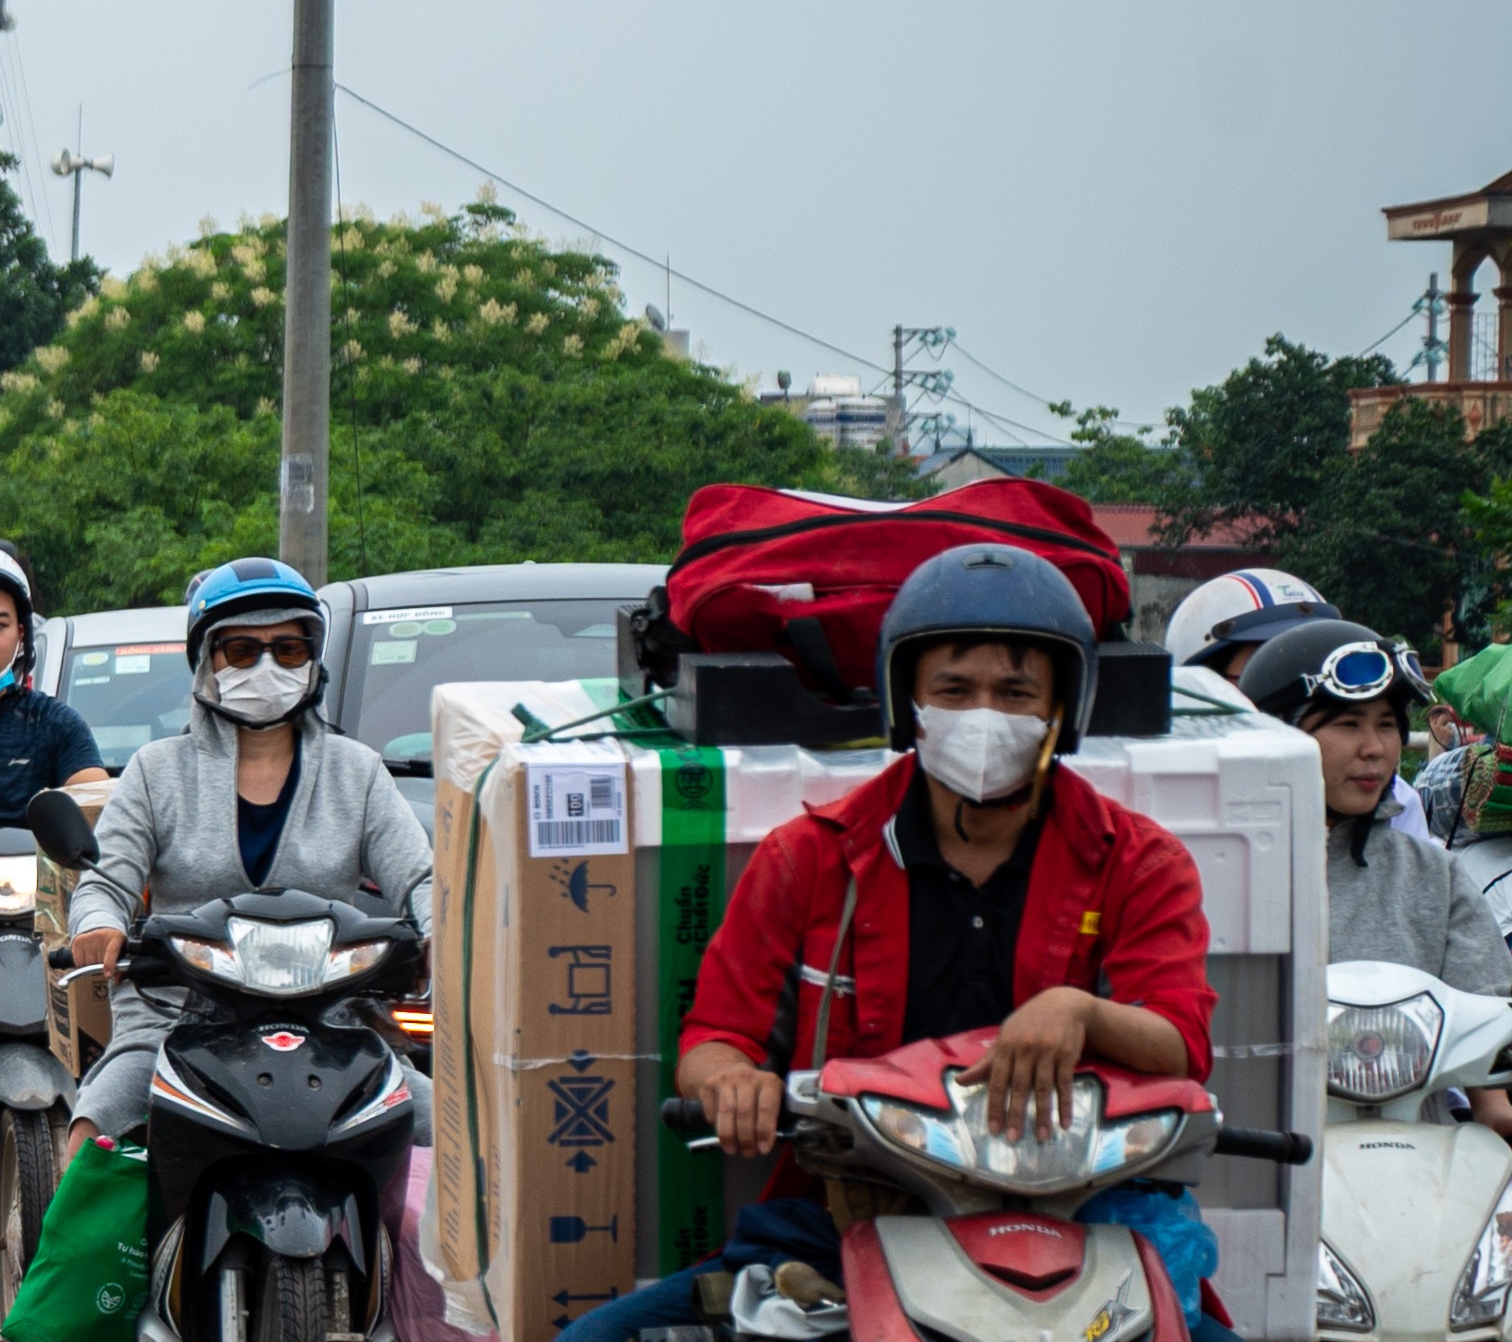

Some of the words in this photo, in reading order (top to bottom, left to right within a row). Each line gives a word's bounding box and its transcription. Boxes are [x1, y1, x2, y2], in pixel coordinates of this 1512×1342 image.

[568, 793, 583, 817] 100
[258, 1023, 311, 1034] HONDA
[1359, 1141, 1417, 1150] HONDA
[988, 1223, 1064, 1239] HONDA
